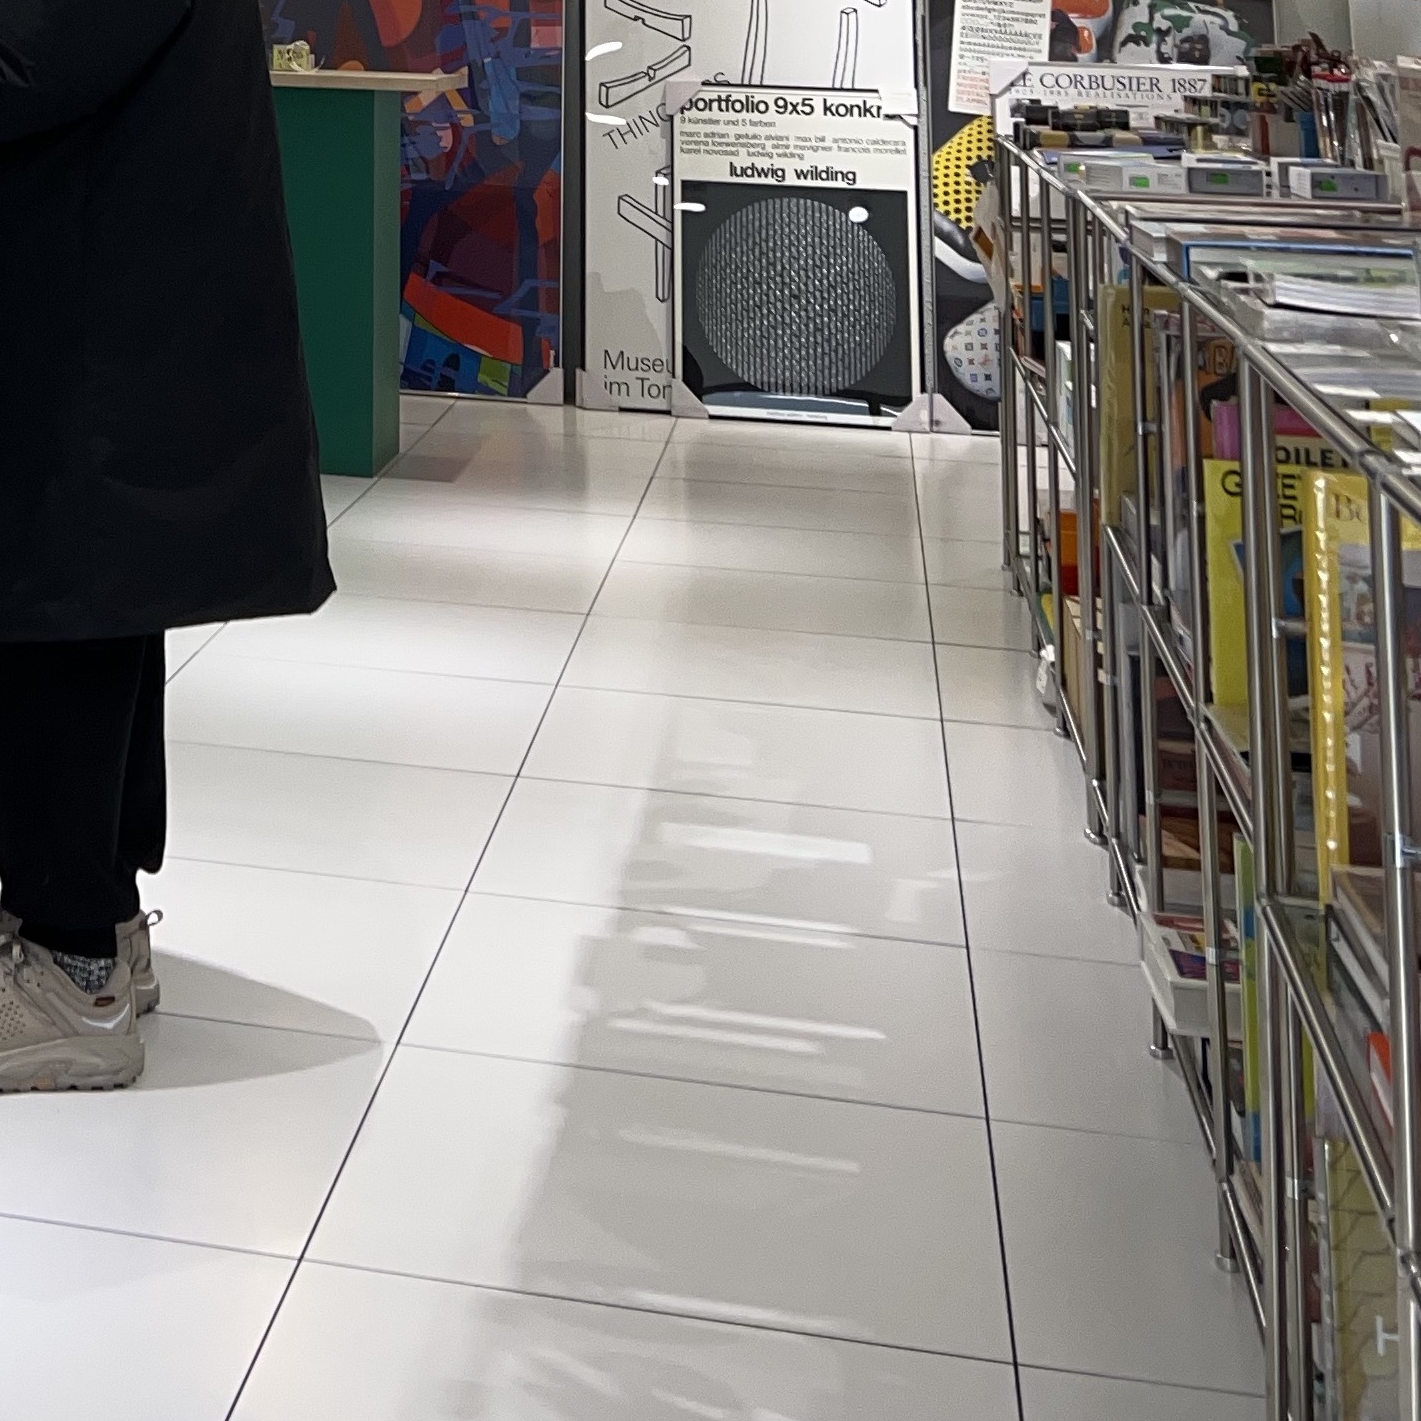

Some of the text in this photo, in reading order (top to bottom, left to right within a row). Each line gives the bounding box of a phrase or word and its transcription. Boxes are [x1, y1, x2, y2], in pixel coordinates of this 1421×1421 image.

[1039, 73, 1162, 93] CORBUSIER
[1171, 78, 1208, 94] 1887
[681, 94, 882, 118] portfolio 9x5 konkr
[723, 118, 740, 126] und
[729, 161, 857, 185] ludwig wilding
[604, 350, 672, 374] Museu
[604, 375, 630, 397] im
